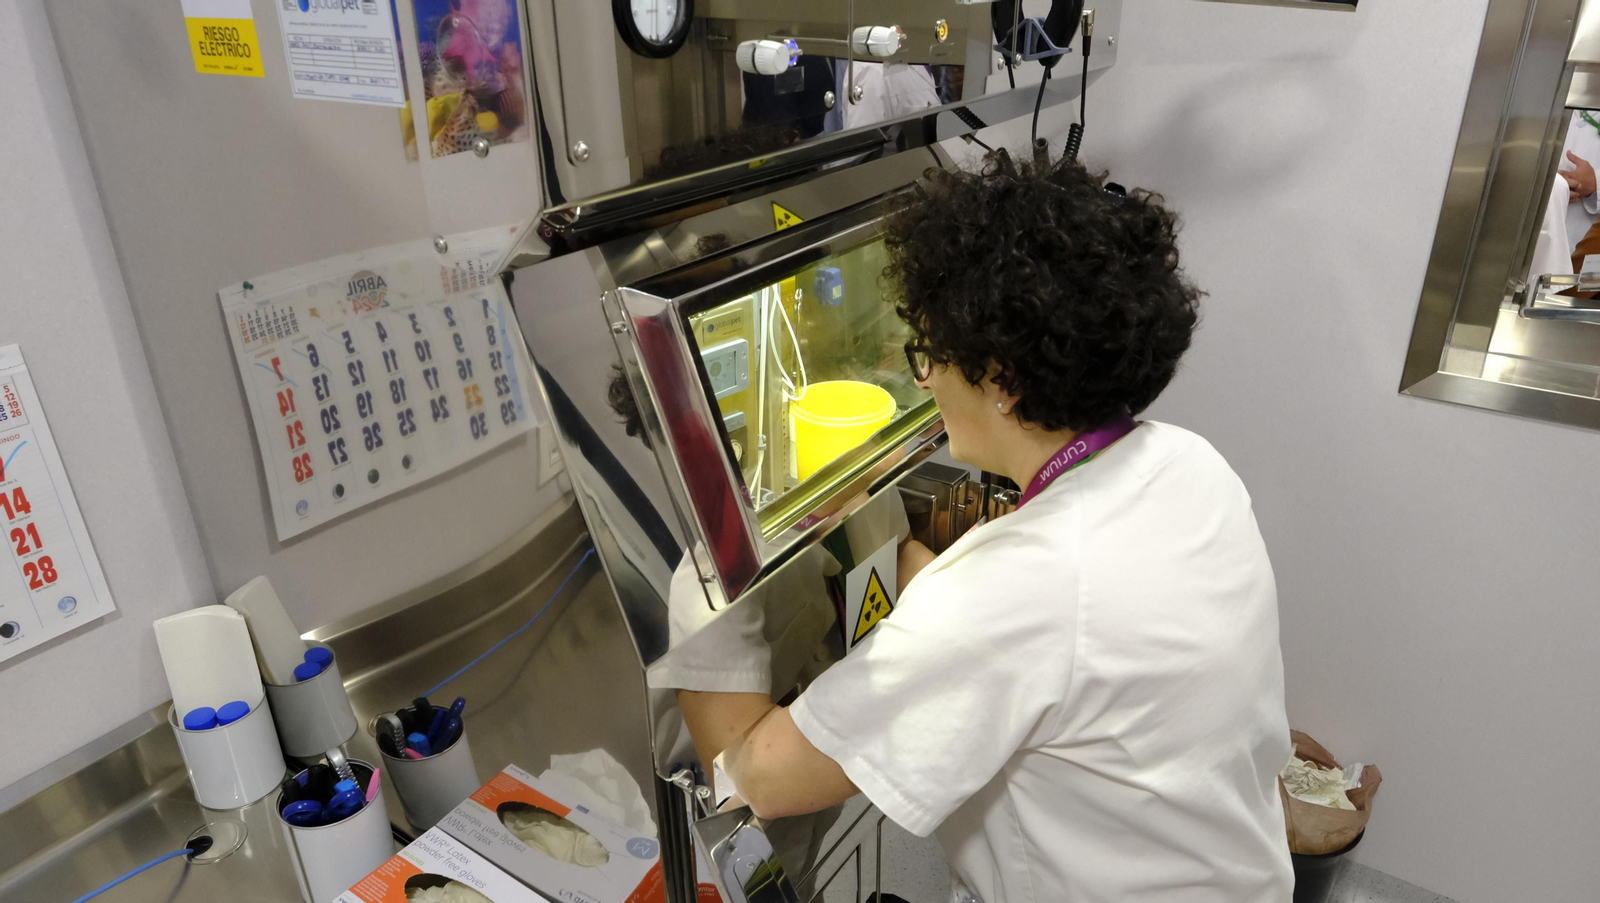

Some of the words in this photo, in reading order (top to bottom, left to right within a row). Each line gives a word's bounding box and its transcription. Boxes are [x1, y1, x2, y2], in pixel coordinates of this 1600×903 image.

[202, 26, 240, 42] RIESGO
[199, 41, 252, 58] ELECTRICO
[2, 385, 10, 393] 5
[4, 392, 16, 402] 12
[8, 400, 18, 410] 19
[10, 408, 22, 418] 26
[0, 486, 32, 520] 14
[10, 522, 43, 556] 21
[22, 555, 58, 590] 28
[412, 840, 445, 862] powder
[440, 857, 460, 872] free
[457, 868, 486, 889] gloves
[446, 846, 471, 866] Latex
